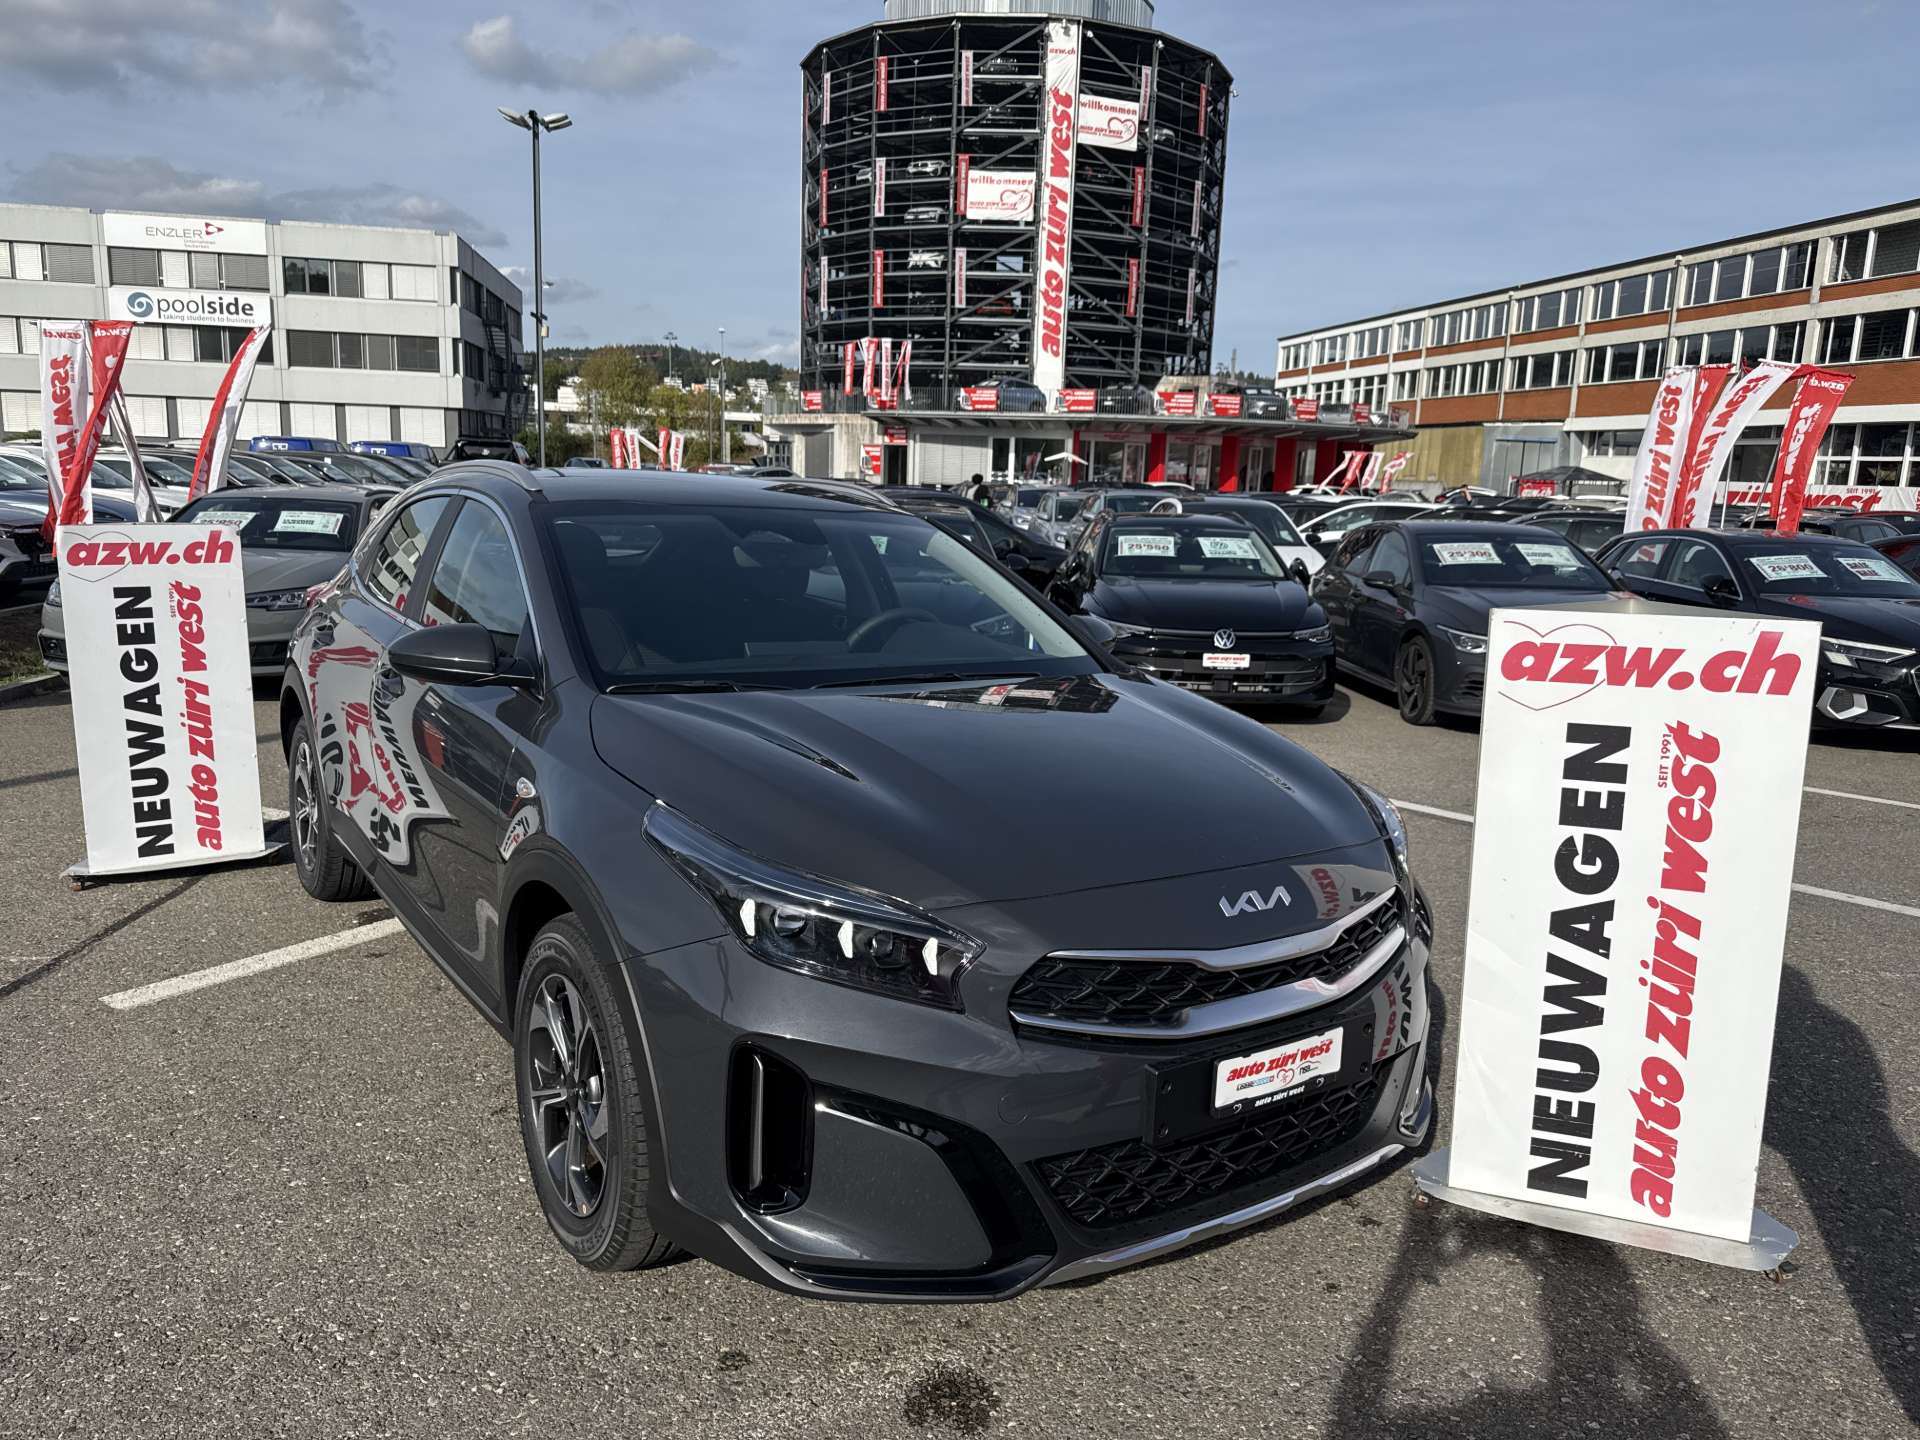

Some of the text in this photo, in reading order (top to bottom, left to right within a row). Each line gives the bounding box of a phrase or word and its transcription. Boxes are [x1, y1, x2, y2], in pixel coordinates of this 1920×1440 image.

[1080, 100, 1137, 115] willkommen
[970, 176, 1033, 185] willkommen
[145, 226, 203, 238] ENZLER
[1040, 86, 1073, 358] auto züri west
[157, 295, 254, 319] poolside
[163, 314, 185, 322] taking
[187, 314, 216, 322] students
[226, 316, 256, 324] business
[1645, 384, 1683, 512] züri west
[66, 530, 234, 566] azw.ch
[1500, 631, 1801, 697] azw.ch
[113, 585, 175, 859] NEUWAGEN
[169, 580, 223, 851] auto züri west
[1658, 733, 1672, 788] SEIT 1991
[1218, 886, 1292, 917] KIA
[1527, 721, 1632, 1199] NEUWAGEN
[1628, 720, 1720, 1218] auto züri west
[1226, 1059, 1267, 1083] auto
[1265, 1048, 1300, 1073] züri
[1300, 1039, 1334, 1062] west
[1254, 1096, 1272, 1108] auto
[1288, 1085, 1305, 1097] west
